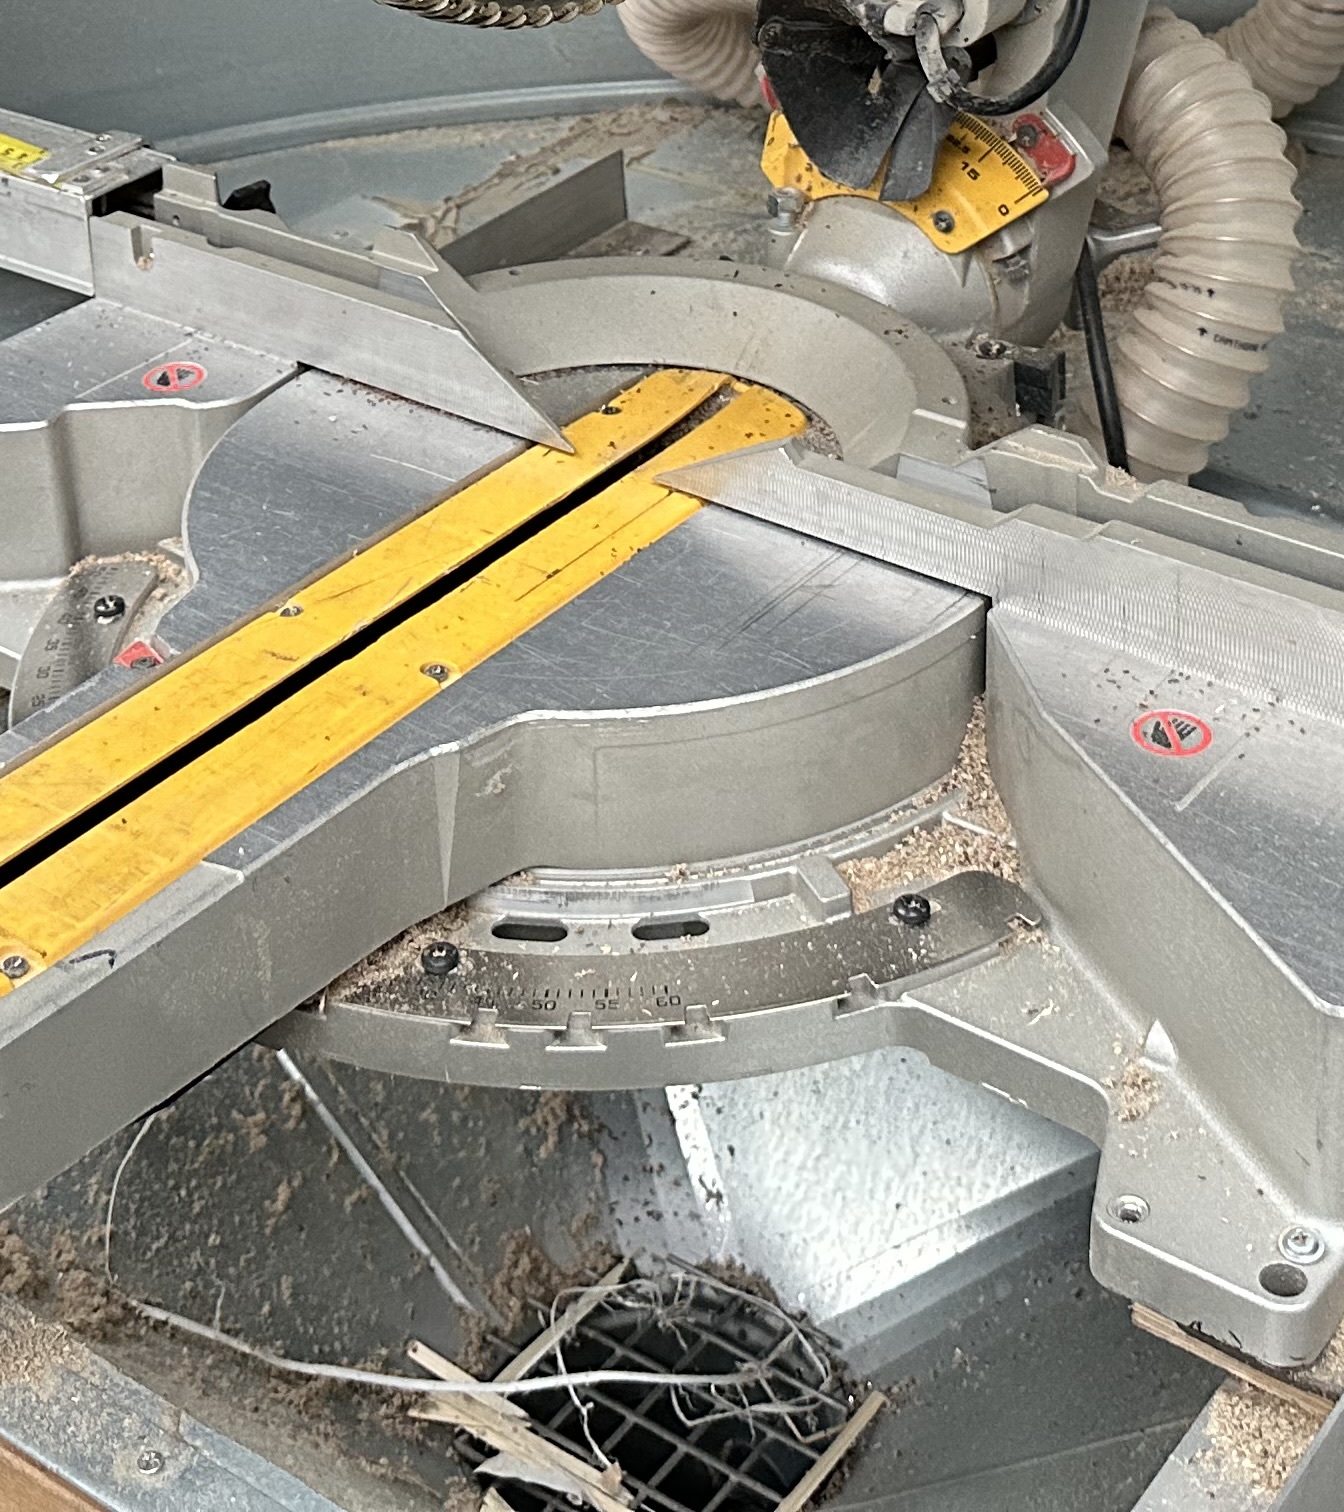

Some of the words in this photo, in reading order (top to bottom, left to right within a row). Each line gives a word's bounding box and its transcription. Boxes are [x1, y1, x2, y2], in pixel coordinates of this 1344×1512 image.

[961, 161, 981, 181] 15
[997, 204, 1010, 216] 0
[531, 999, 557, 1012] 50
[594, 999, 620, 1011] 55
[655, 995, 682, 1007] 60
